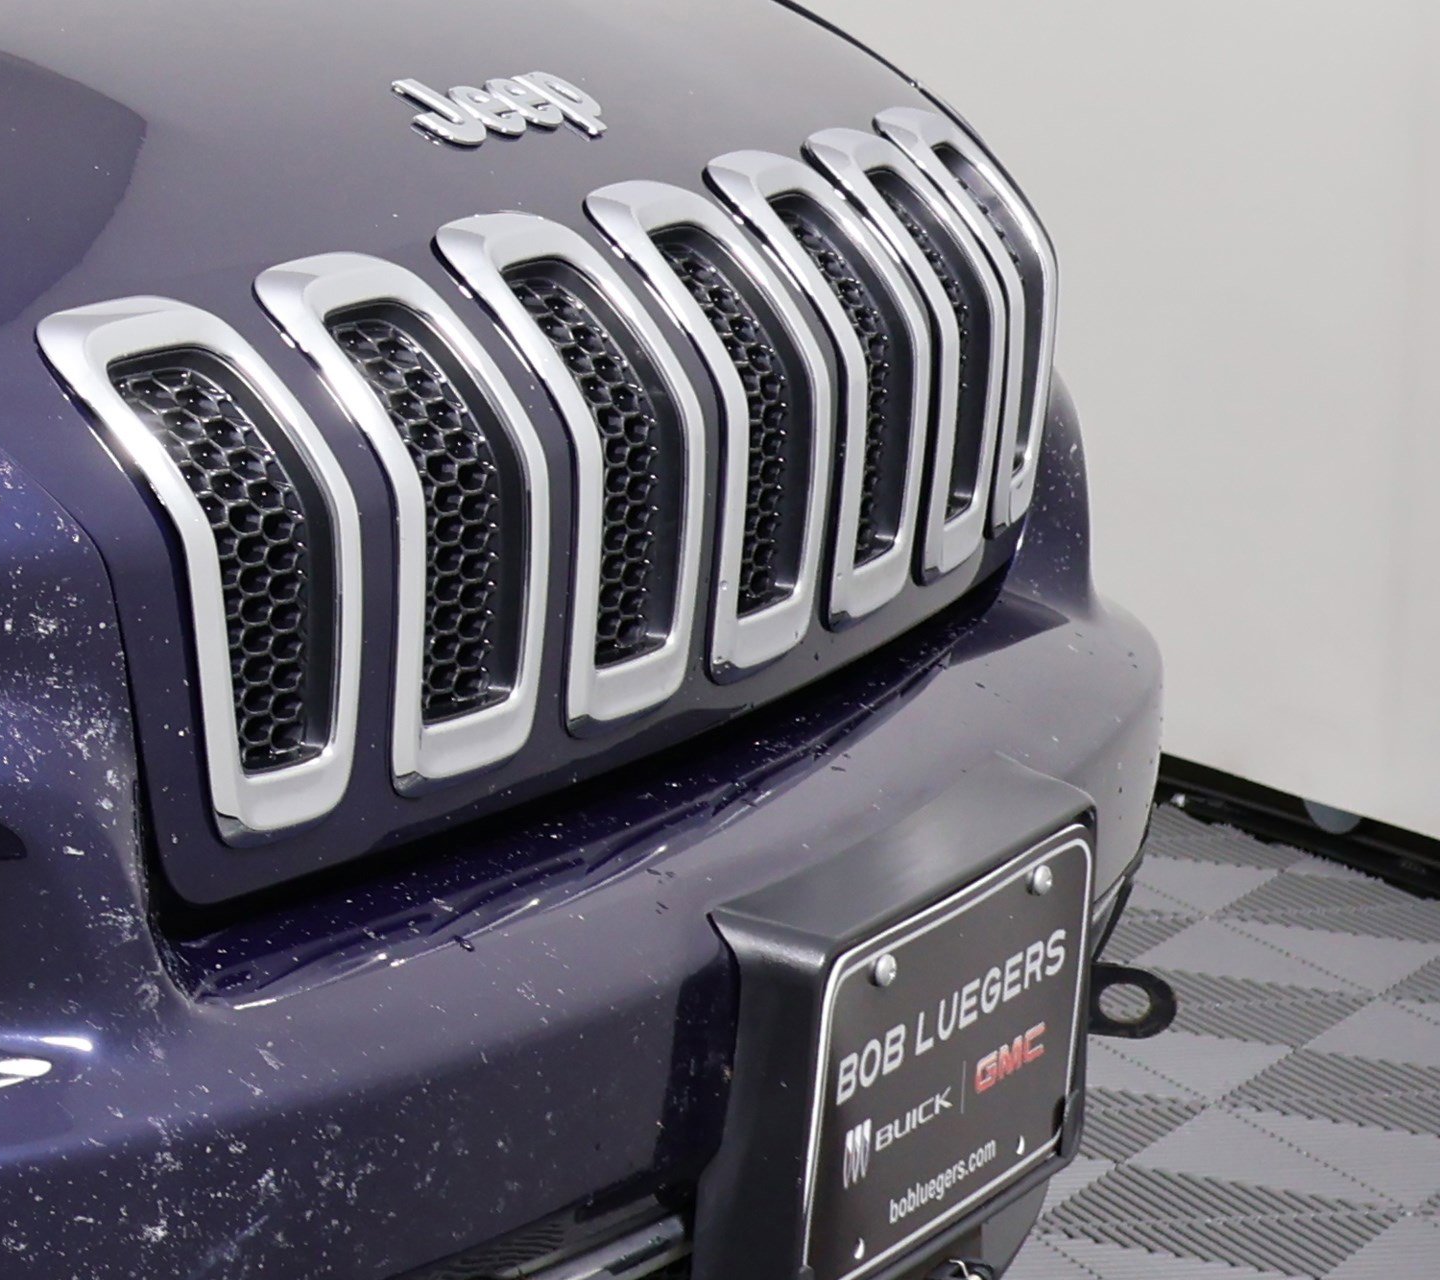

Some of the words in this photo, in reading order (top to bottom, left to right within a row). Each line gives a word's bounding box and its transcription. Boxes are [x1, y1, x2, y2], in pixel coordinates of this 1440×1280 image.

[391, 71, 608, 146] Jeep
[836, 1024, 906, 1106] BOB
[915, 928, 1067, 1057] LUEGERS
[974, 1021, 1047, 1094] GMC
[875, 1086, 953, 1151] BUICK
[889, 1139, 996, 1224] bobluegers.com
